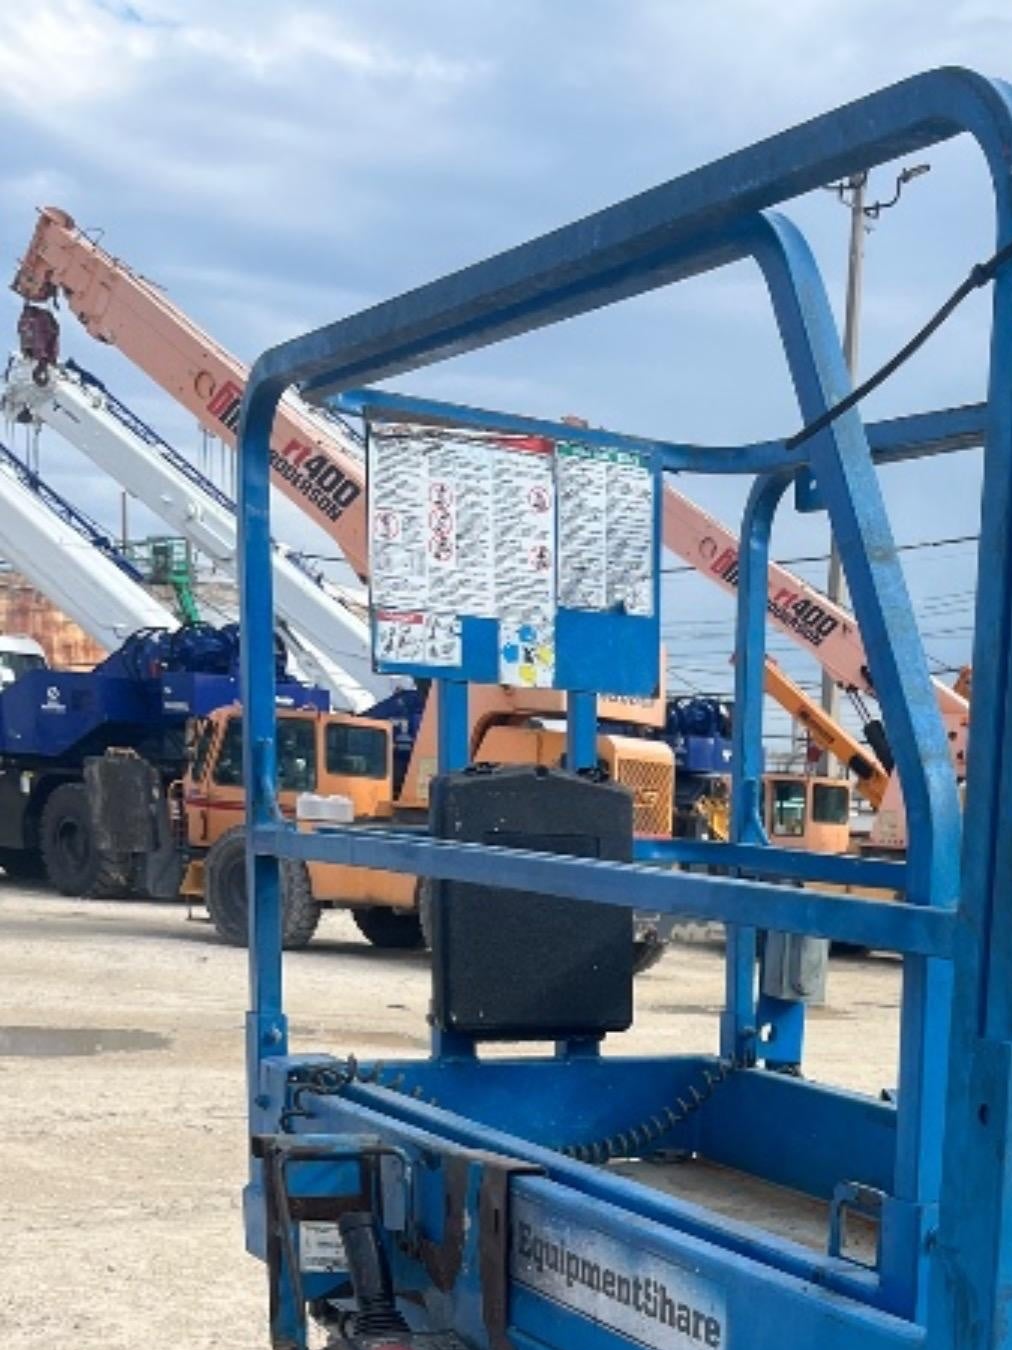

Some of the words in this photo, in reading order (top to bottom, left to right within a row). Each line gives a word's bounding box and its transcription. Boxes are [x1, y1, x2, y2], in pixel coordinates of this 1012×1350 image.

[269, 448, 343, 523] RODERSON
[281, 438, 361, 509] rt400
[773, 588, 839, 637] rt400
[517, 1219, 721, 1349] EquipmentShare
